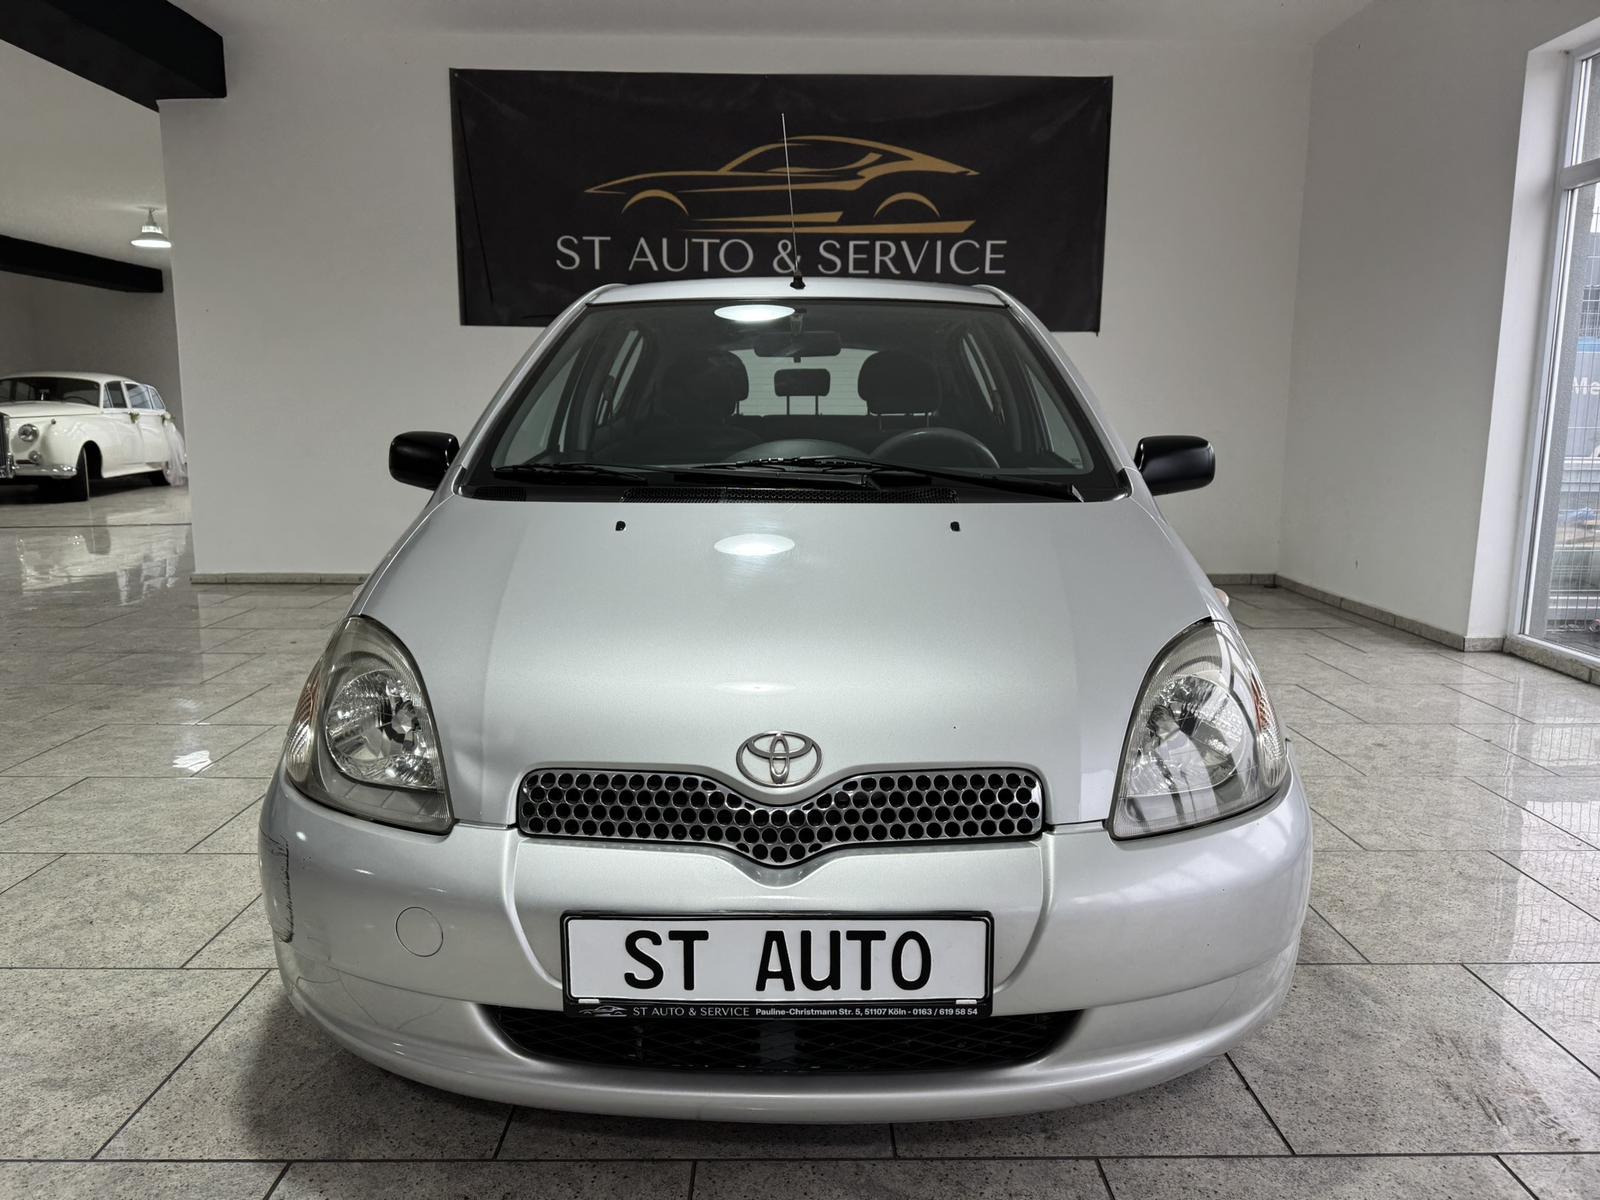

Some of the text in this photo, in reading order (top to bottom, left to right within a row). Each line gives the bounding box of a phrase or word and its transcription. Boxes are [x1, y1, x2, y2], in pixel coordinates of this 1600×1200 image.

[556, 235, 1008, 275] ST AUTO & SERVICE
[623, 929, 932, 992] ST AUTO
[633, 1006, 648, 1016] ST
[651, 1007, 685, 1016] AUTO
[688, 1007, 697, 1017] &
[700, 1007, 750, 1017] SERVICE
[755, 1007, 838, 1016] Pauline-Christmann
[838, 1007, 854, 1016] Str.
[855, 1008, 863, 1017] 5,
[864, 1008, 887, 1016] 51107
[888, 1007, 907, 1016] Köln
[912, 1008, 933, 1016] 0163
[938, 1008, 954, 1016] 619
[955, 1008, 966, 1016] 58
[967, 1008, 978, 1016] 54
